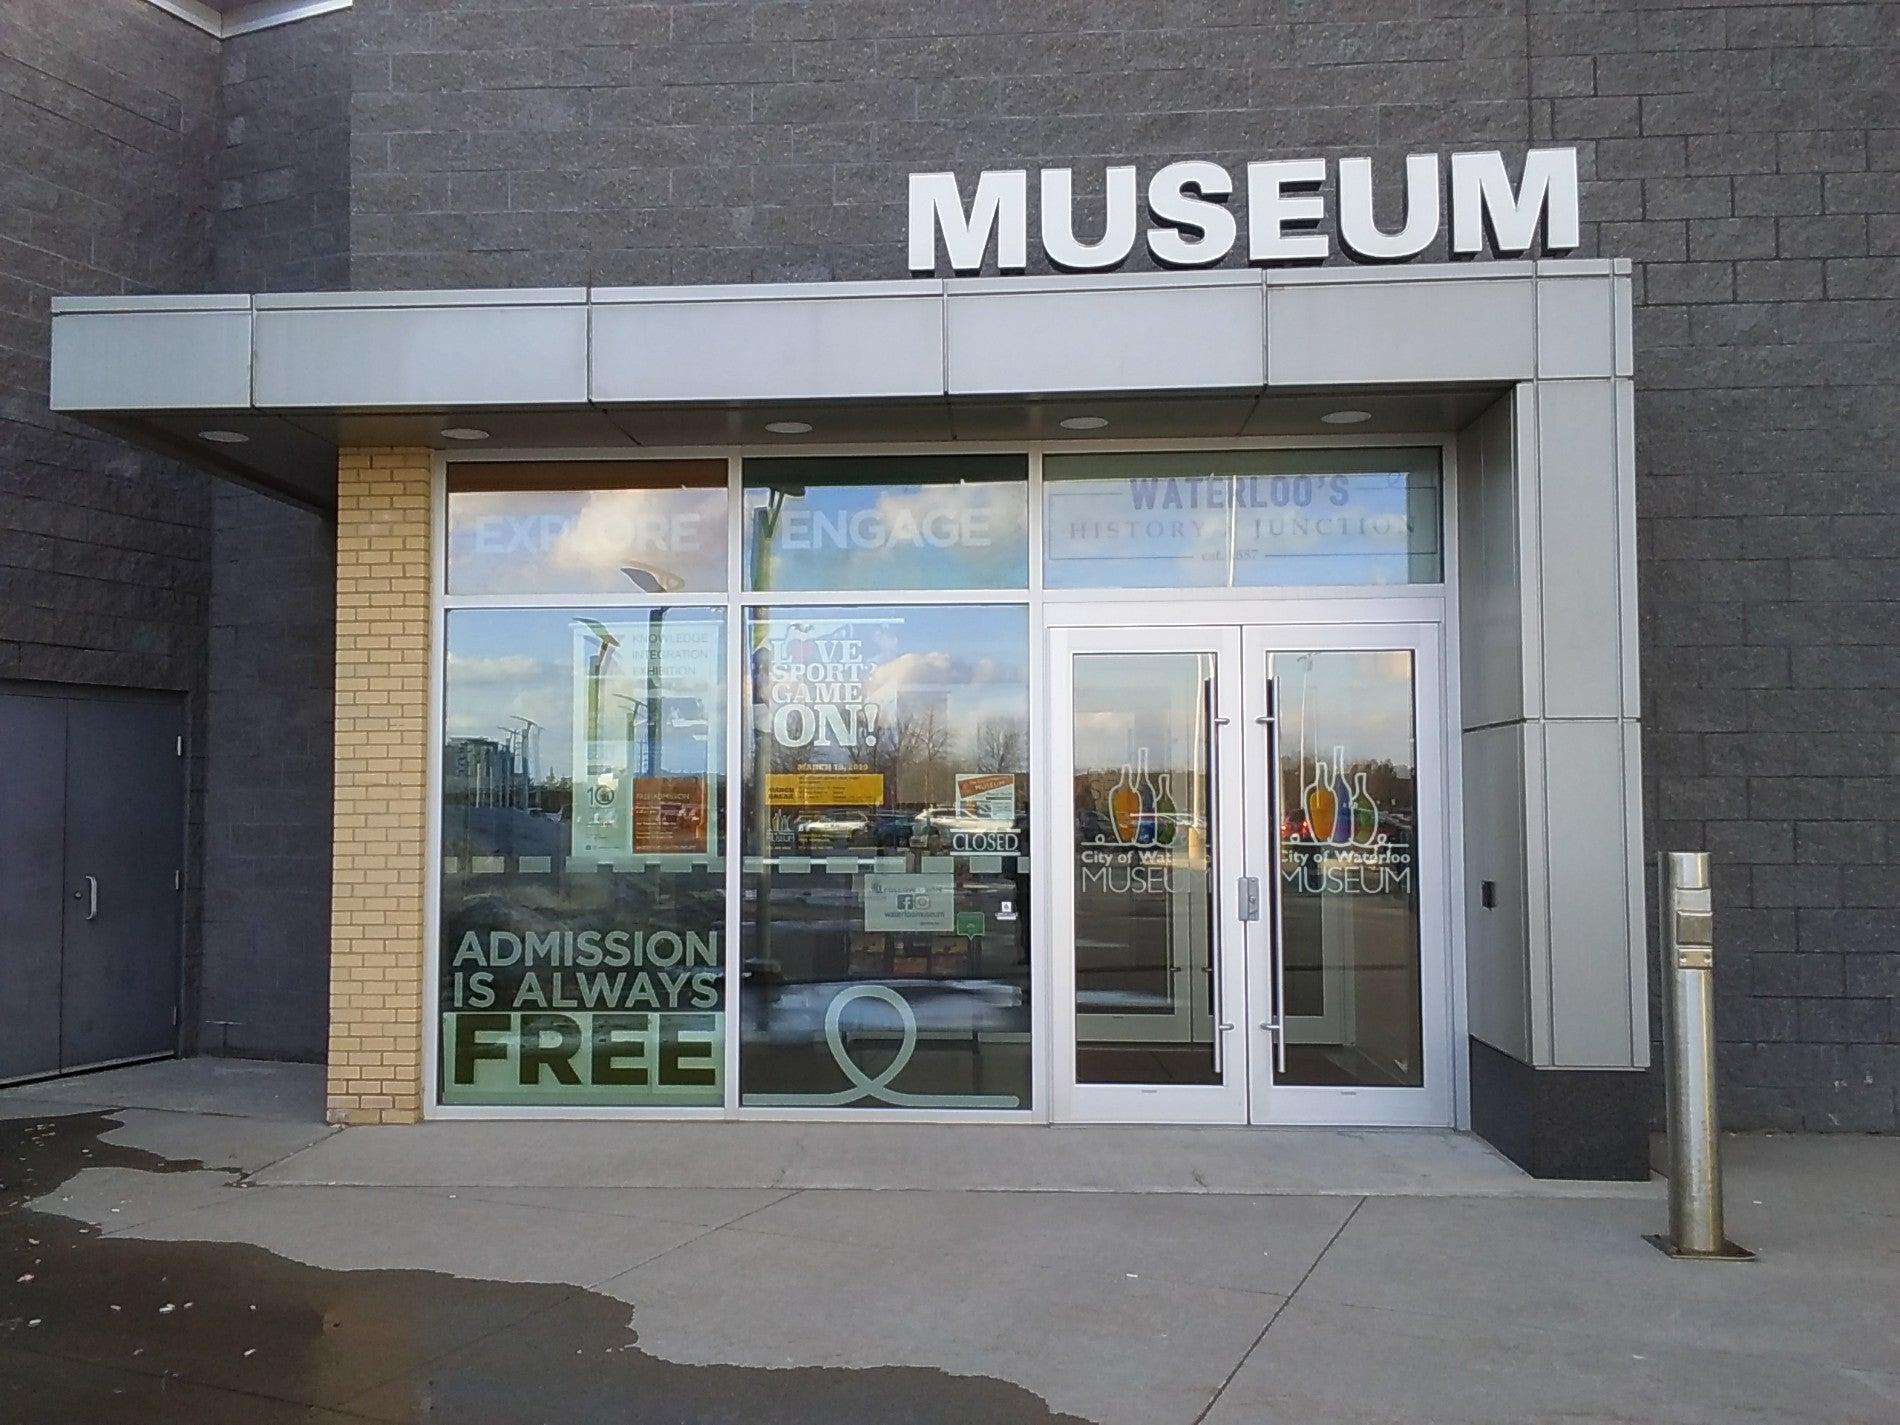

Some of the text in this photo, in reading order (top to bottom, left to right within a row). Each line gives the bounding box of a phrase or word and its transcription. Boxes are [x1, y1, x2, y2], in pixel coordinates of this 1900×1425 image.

[908, 147, 1580, 274] MUSEUM
[1129, 474, 1350, 510] WATERLOO'S
[475, 513, 703, 554] EXPORE
[781, 506, 993, 549] ENGAGE
[1069, 519, 1206, 541] HISTORY
[632, 648, 708, 661] INTEGRATION
[771, 683, 864, 704] GAME
[773, 703, 880, 748] ON!
[952, 832, 1019, 852] CLOSED
[1081, 851, 1113, 867] City
[1117, 850, 1134, 864] of
[1313, 850, 1331, 864] of
[1334, 849, 1411, 865] Waterloo
[1281, 866, 1412, 895] MUSEUM
[452, 930, 718, 967] ADMISSION
[453, 971, 719, 1009] IS ALWAYS
[454, 1013, 717, 1086] FREE
